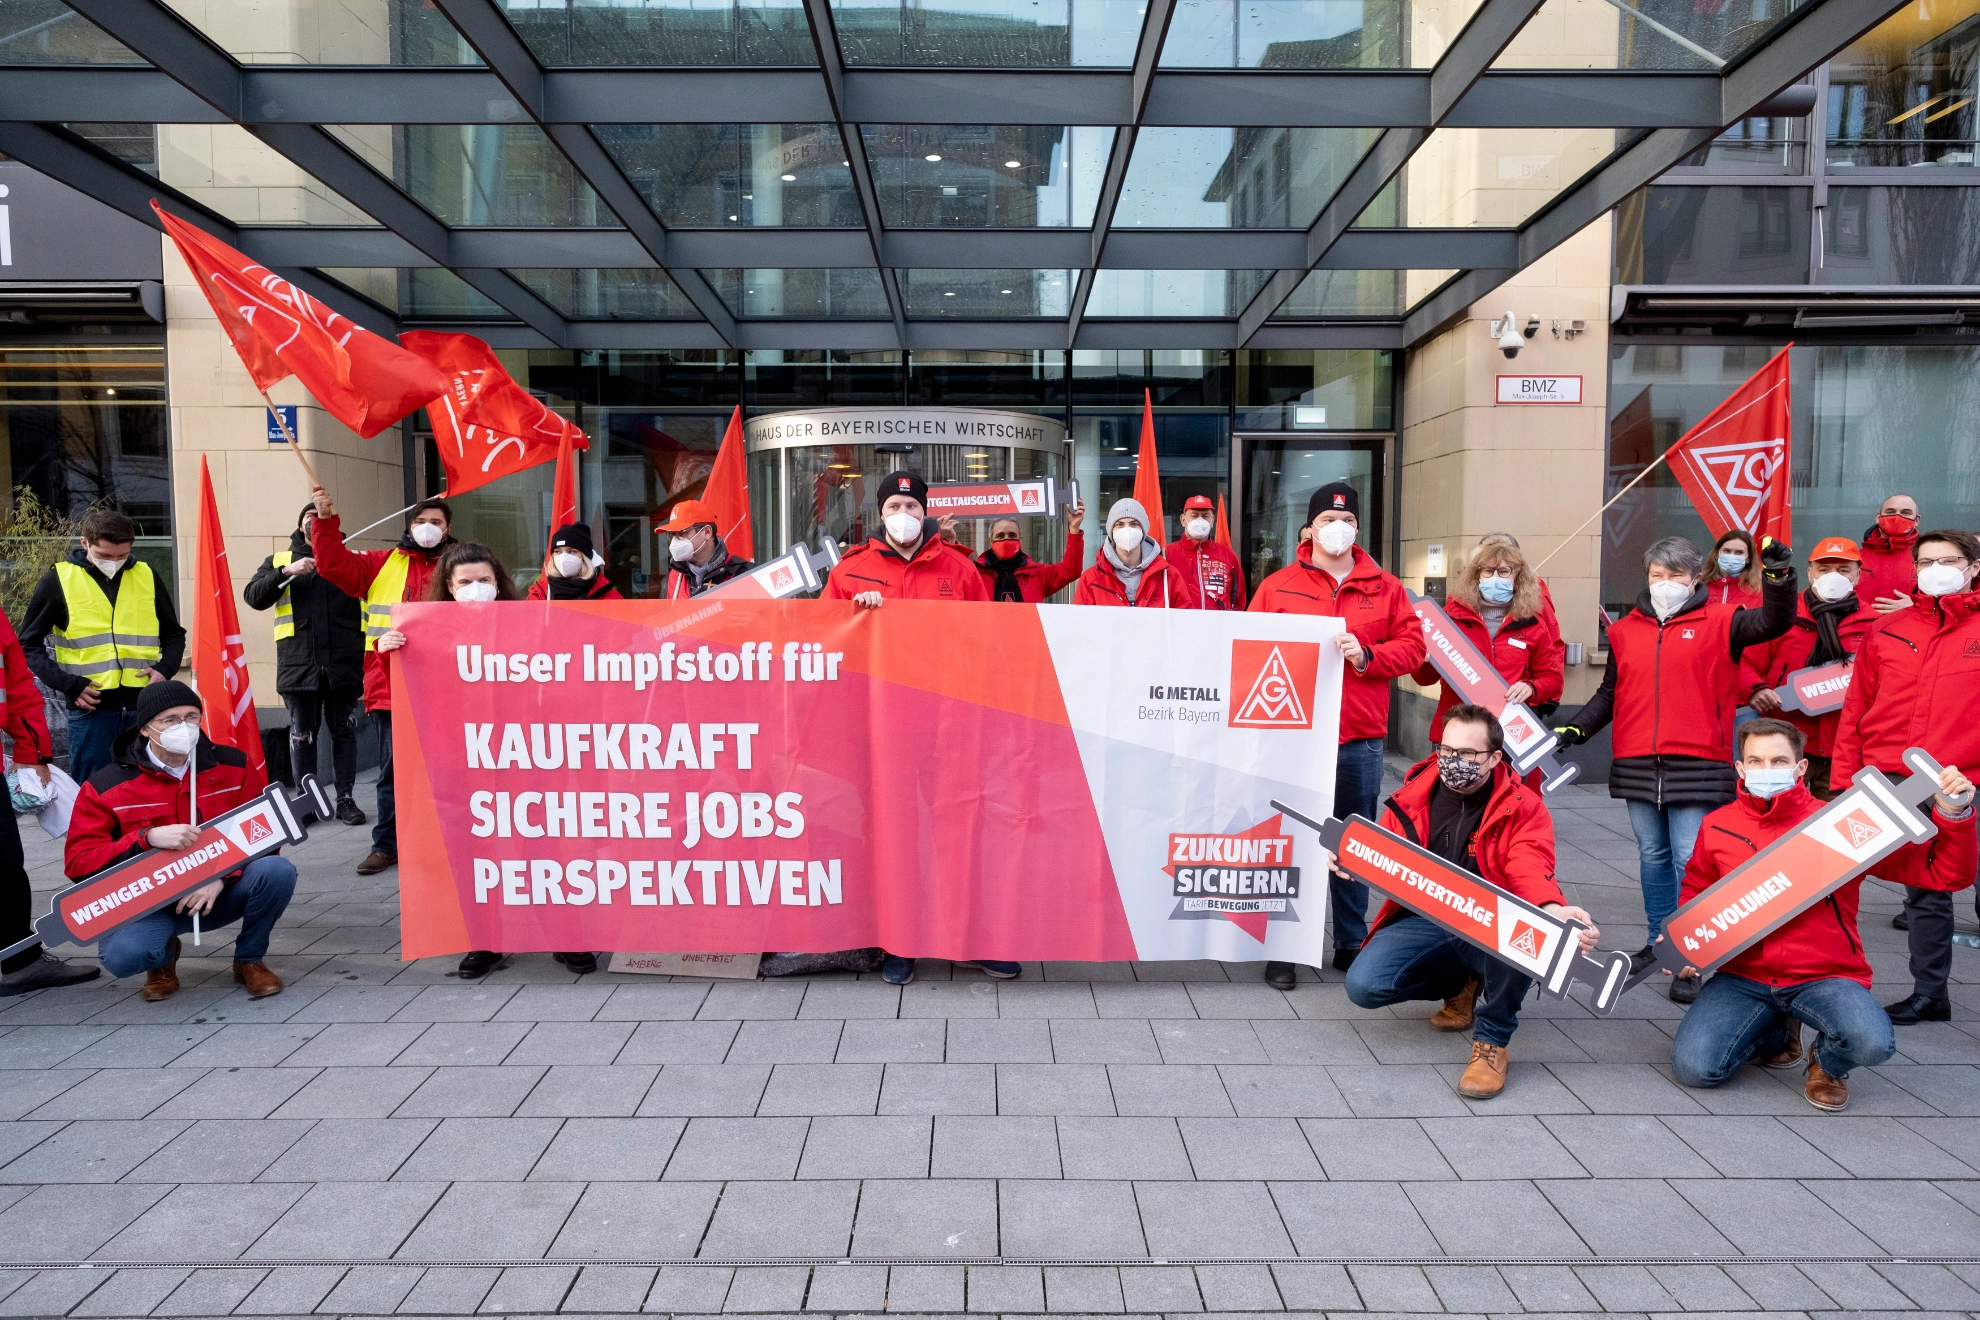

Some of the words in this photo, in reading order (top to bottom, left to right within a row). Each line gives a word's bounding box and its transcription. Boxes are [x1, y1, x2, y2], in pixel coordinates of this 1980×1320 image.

[1521, 379, 1557, 393] BMZ
[276, 407, 287, 425] 5
[755, 426, 782, 441] HAUS
[786, 423, 813, 438] DER
[821, 420, 946, 435] BAYERISCHEN
[955, 421, 1044, 442] WIRTSCHAFT
[653, 600, 725, 641] ÜBERNAHME
[1421, 617, 1434, 633] %
[1431, 629, 1482, 686] VOLUMEN
[456, 644, 571, 682] Unser
[583, 641, 773, 691] Impfstoff
[782, 641, 843, 682] für
[1149, 685, 1164, 700] IG
[1167, 686, 1221, 702] METALL
[1801, 672, 1853, 699] WENIG
[1138, 705, 1175, 720] Bezirk
[1178, 706, 1220, 724] Bayern
[464, 723, 760, 770] KAUFKRAFT
[469, 790, 672, 839] SICHERE
[682, 791, 805, 849] JOBS
[1172, 837, 1288, 864] ZUKUNFT
[70, 876, 154, 926] WENIGER
[152, 838, 229, 886] STUNDEN
[473, 858, 844, 906] PERSPEKTIVEN
[1177, 868, 1296, 895] SICHERN.
[1345, 837, 1495, 928] ZUKUNFTSVERTRÄGE
[1186, 900, 1260, 911] TARIFBEWEGUNG
[1683, 935, 1700, 952] 4
[1694, 923, 1717, 944] %
[1710, 871, 1793, 932] VOLUMEN
[625, 958, 662, 969] AMBERG
